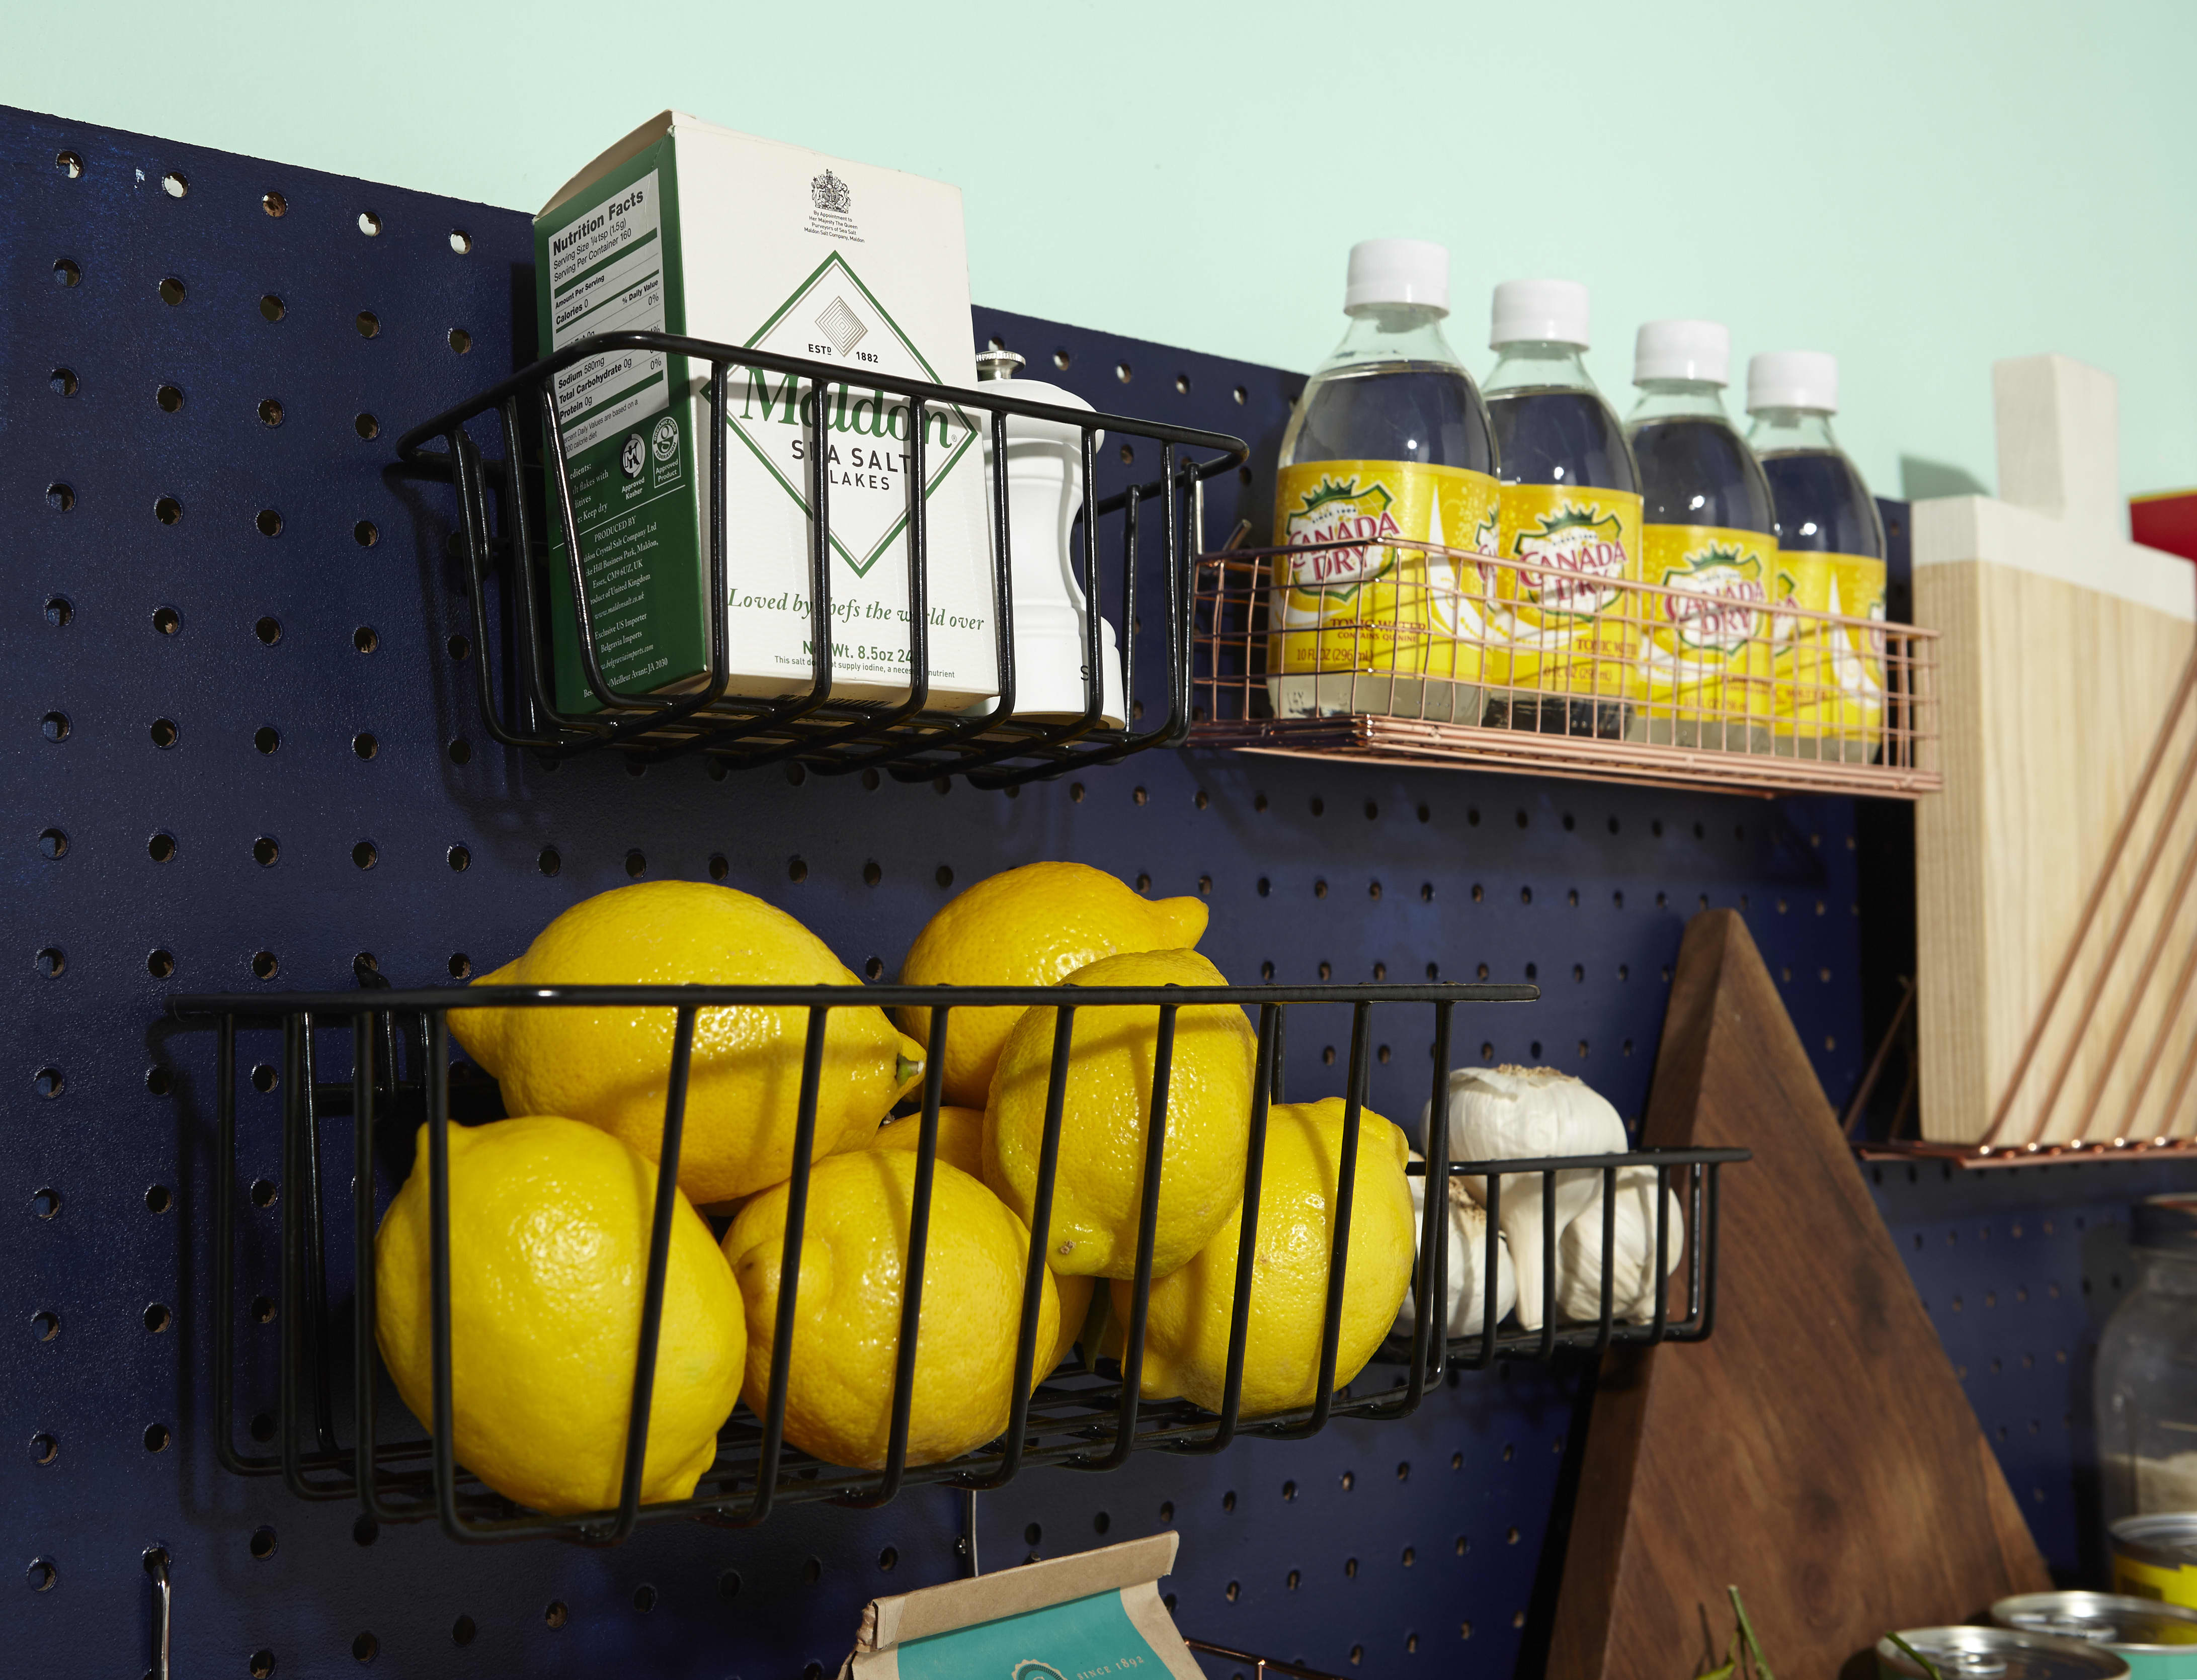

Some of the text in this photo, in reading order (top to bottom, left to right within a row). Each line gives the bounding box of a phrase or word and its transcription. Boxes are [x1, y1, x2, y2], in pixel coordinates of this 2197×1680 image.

[553, 191, 643, 256] Nutrition Facts
[811, 222, 833, 230] Purveyors
[818, 217, 834, 225] Majesty
[820, 212, 847, 221] Appointment
[554, 250, 575, 270] Serving
[577, 242, 589, 255] Size
[610, 218, 626, 236] (1.5g)
[554, 228, 631, 282] Serving Per Container 160
[555, 276, 604, 309] Amount Per Serving
[622, 280, 659, 305] % Daily Value
[648, 292, 659, 305] 0%
[556, 299, 588, 324] Calories 0
[650, 357, 662, 370] 0%
[856, 352, 878, 363] 1882
[558, 357, 605, 389] Sodium 580mg
[559, 390, 574, 404] Total
[577, 364, 622, 394] Carbohydrate
[624, 358, 632, 368] 0g
[560, 396, 592, 419] Protein 0g
[563, 431, 577, 444] ercent
[578, 426, 588, 436] Daily
[589, 417, 603, 430] Values
[612, 404, 626, 416] based
[574, 436, 588, 448] calorie
[589, 431, 597, 440] diet
[656, 458, 679, 474] Approved
[792, 440, 911, 474] SA SALT
[569, 464, 592, 479] edients:
[580, 478, 595, 491] flakes
[596, 469, 608, 482] with
[658, 469, 677, 482] Product
[830, 470, 889, 490] LAKES
[621, 476, 644, 493] Approved
[625, 487, 642, 500] Kosher
[584, 503, 607, 521] Keep dry
[594, 521, 627, 542] PRODUCED
[628, 516, 636, 527] BY
[596, 542, 612, 556] Crystal
[613, 539, 622, 548] Salt
[623, 528, 646, 544] Company
[647, 522, 657, 533] Ltd
[1288, 512, 1400, 568] CANADA
[594, 562, 603, 573] Hill
[603, 555, 623, 568] Business
[623, 547, 636, 559] Park,
[637, 539, 659, 553] Maldon,
[1313, 545, 1368, 580] DRY
[1519, 539, 1627, 587] CANADA
[593, 559, 643, 589] Essex, CM9 6UZ, UK
[590, 574, 650, 605] roduct of United Kingdom
[595, 592, 644, 619] www.maldonsalt.co.uk
[728, 588, 985, 630] Loved by hefs the wld over
[595, 613, 647, 640] Exclusive US Importer
[1338, 631, 1379, 640] CONAINS
[601, 631, 642, 652] Belgravia Imports
[832, 643, 853, 658] Wt.
[858, 645, 893, 661] 8.5oz
[1297, 648, 1307, 660] 10
[584, 689, 594, 698] Bes
[631, 668, 648, 679] Avant:
[648, 662, 655, 675] JA
[656, 657, 668, 669] 2030
[838, 661, 861, 671] supply
[862, 664, 885, 673] iodine,
[928, 670, 955, 678] nutrient
[1077, 1655, 1144, 1680] SINCE 1892
